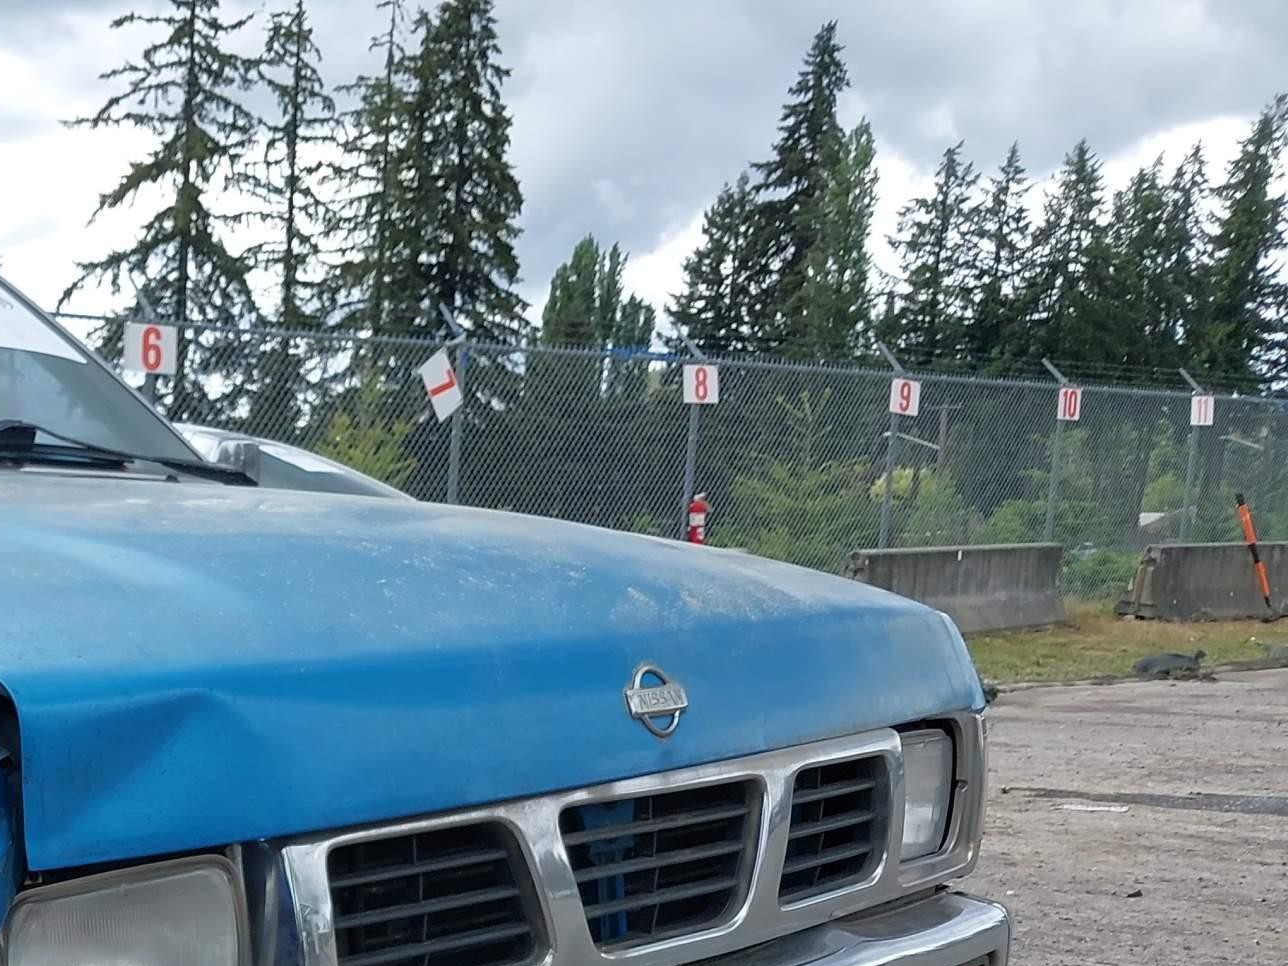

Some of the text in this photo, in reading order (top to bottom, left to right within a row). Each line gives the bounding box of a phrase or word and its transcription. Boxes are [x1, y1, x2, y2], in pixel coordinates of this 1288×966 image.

[143, 327, 161, 371] 6
[695, 367, 708, 401] 8
[899, 382, 911, 412] 9
[1063, 390, 1078, 418] 10
[1197, 398, 1209, 423] 11
[638, 688, 684, 710] NISSAN
